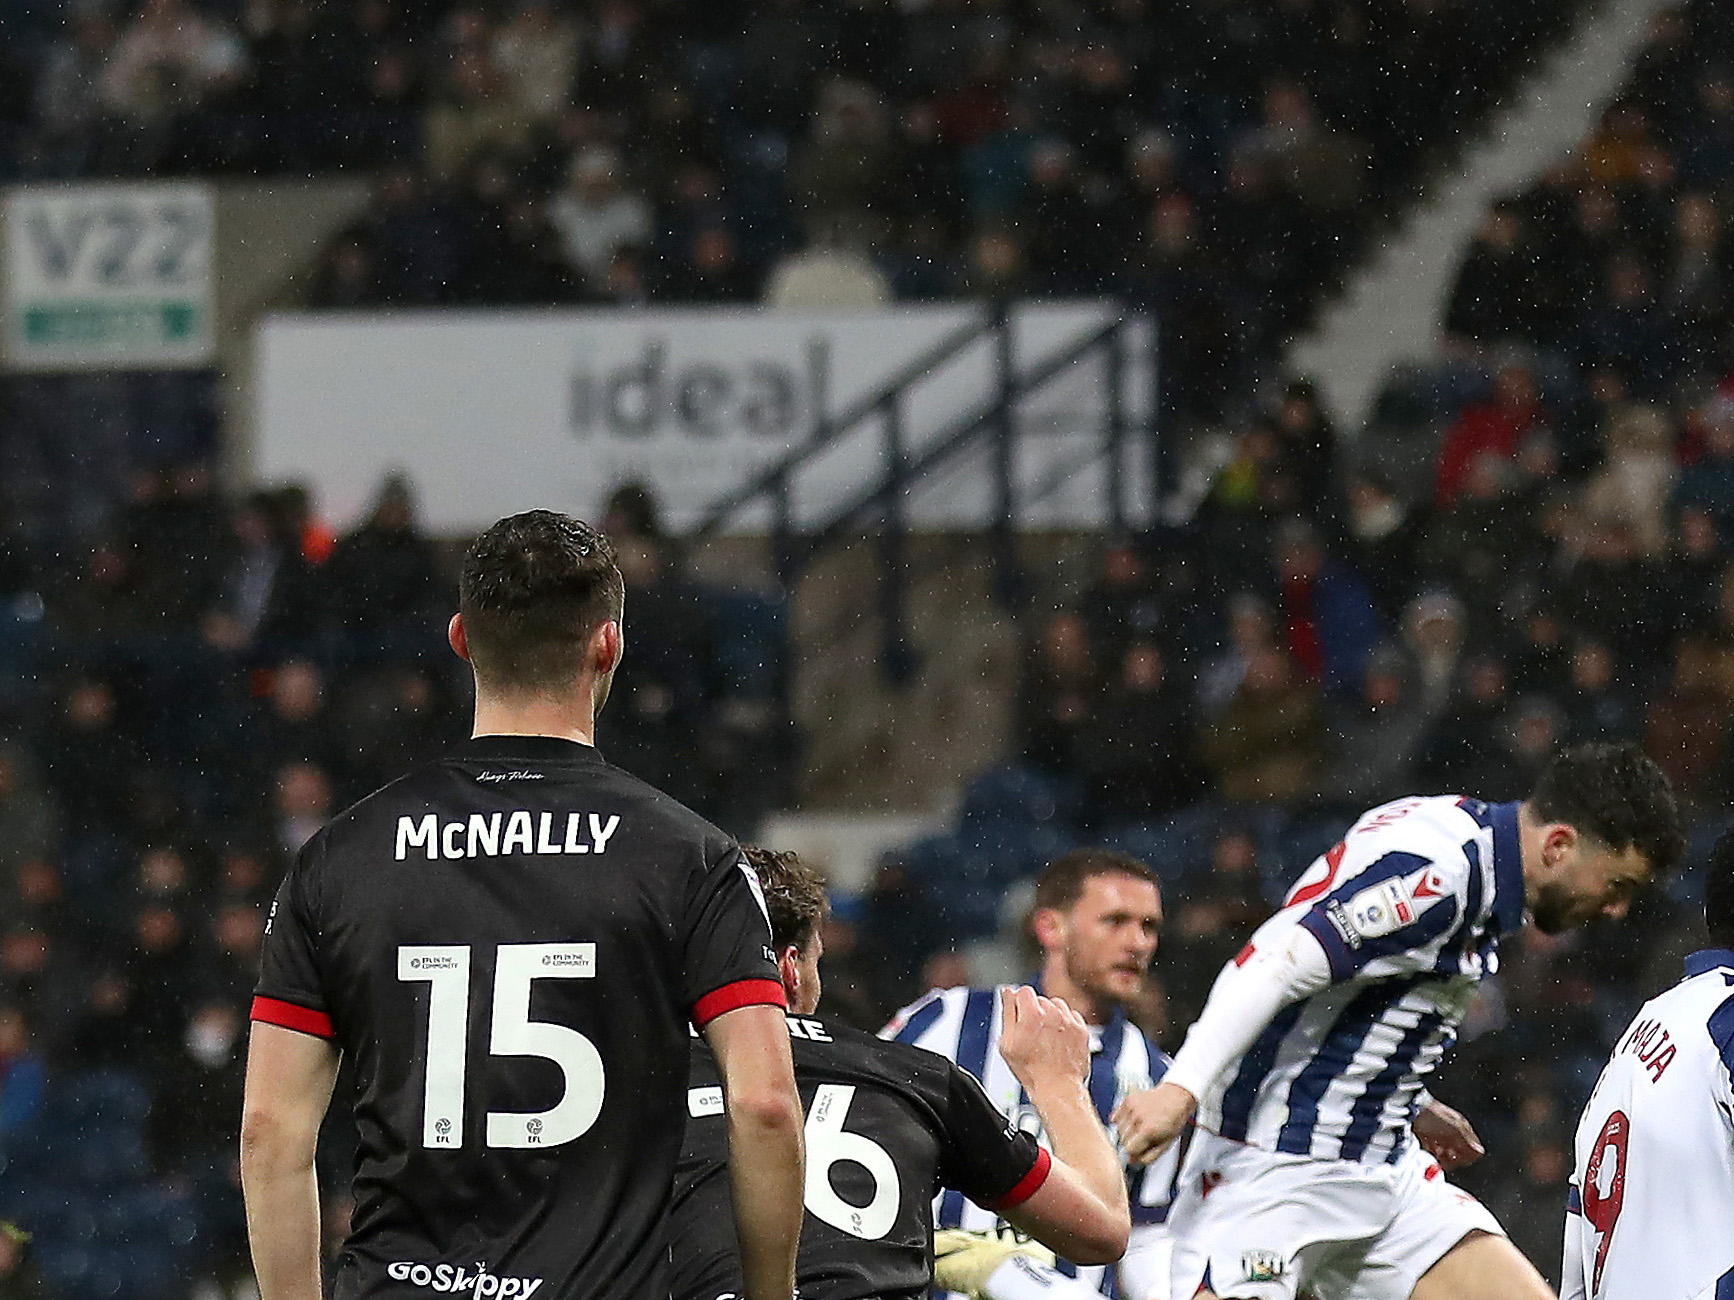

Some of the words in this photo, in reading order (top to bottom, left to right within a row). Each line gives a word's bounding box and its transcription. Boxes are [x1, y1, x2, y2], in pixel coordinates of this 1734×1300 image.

[27, 204, 206, 279] V22
[567, 335, 832, 438] ideal
[395, 811, 621, 860] McNALLY
[397, 942, 605, 1150] 15
[436, 1135, 450, 1144] EFL
[527, 1135, 542, 1144] EFL
